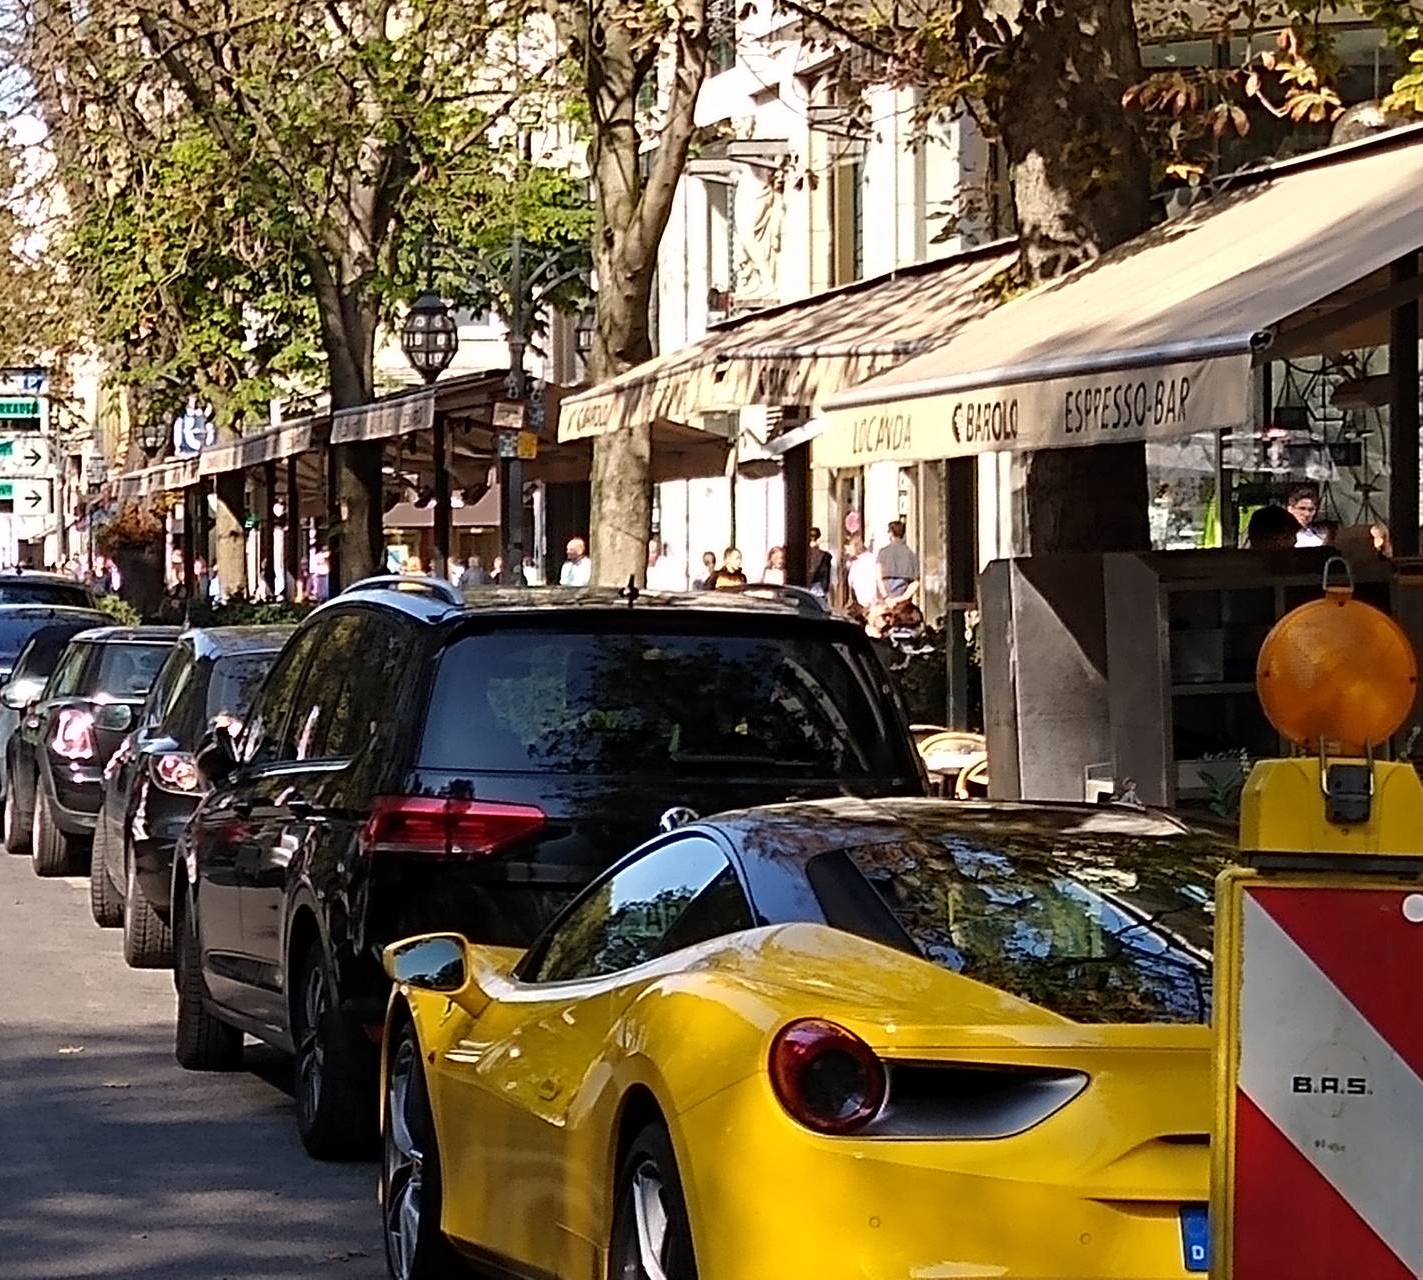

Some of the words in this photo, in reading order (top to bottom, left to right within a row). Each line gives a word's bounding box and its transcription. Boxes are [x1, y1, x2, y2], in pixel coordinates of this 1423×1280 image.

[1065, 377, 1190, 433] ESPRESSO-BAR
[853, 414, 911, 454] LOCANDA
[966, 399, 1018, 442] BAROLO
[1292, 1076, 1374, 1095] B.A.S.
[1192, 1245, 1205, 1260] D
